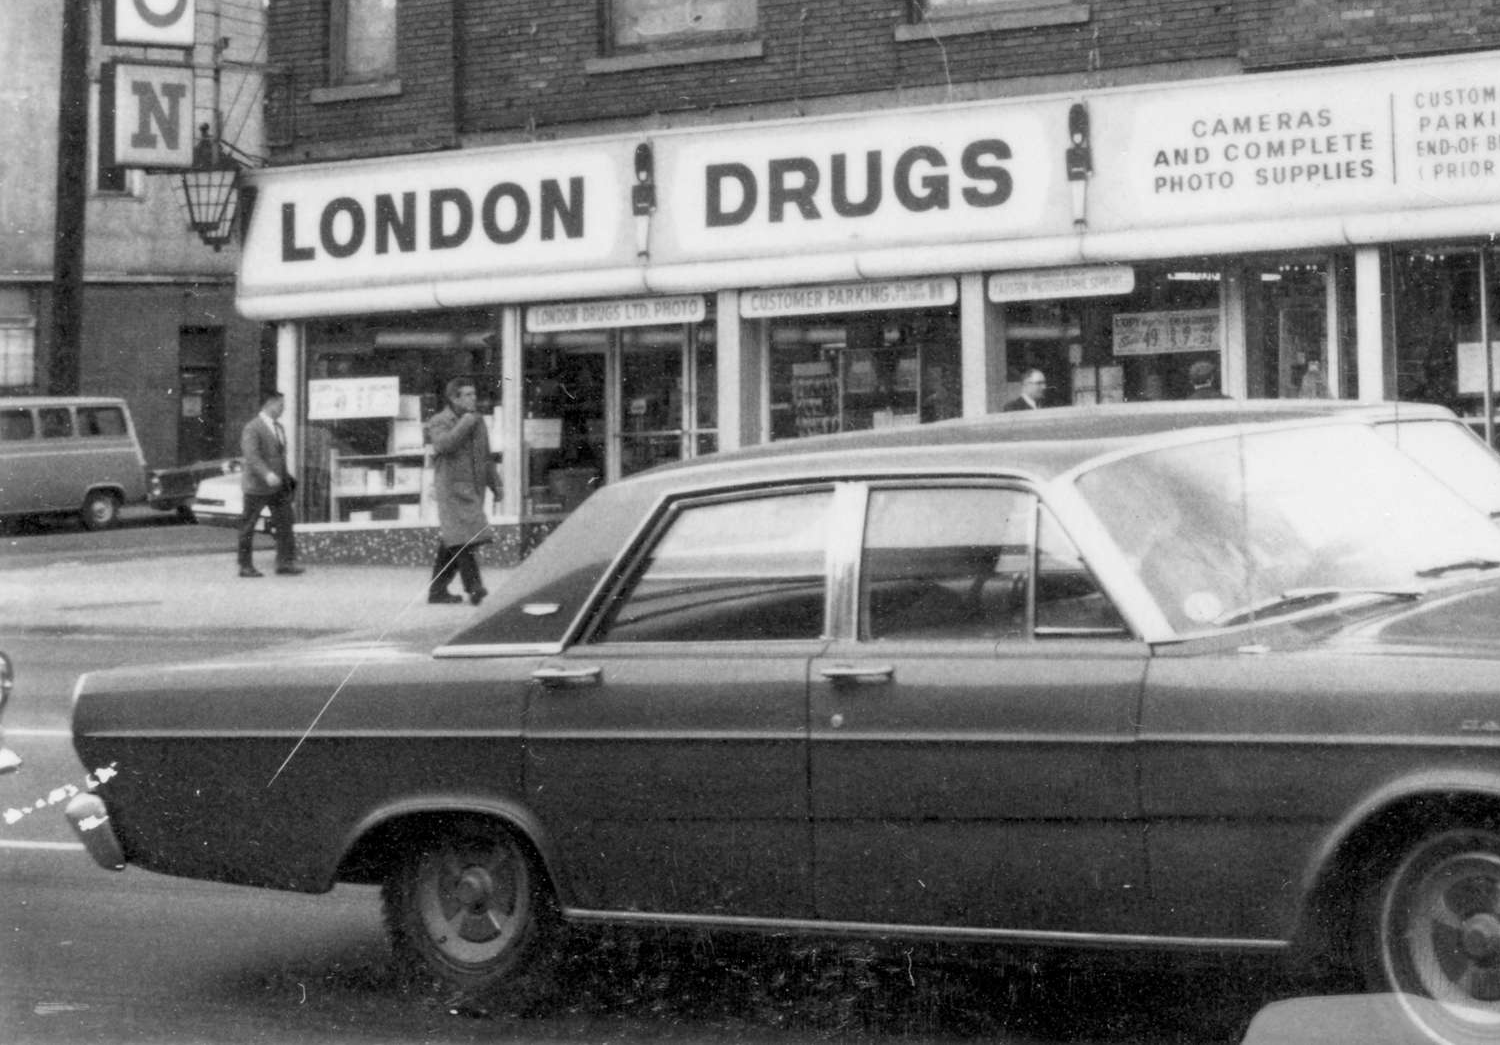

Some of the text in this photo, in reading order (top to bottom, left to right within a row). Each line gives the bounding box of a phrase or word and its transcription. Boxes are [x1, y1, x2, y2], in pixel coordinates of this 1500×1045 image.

[1191, 108, 1333, 139] CAMERAS
[1153, 131, 1375, 168] AND COMPLETE
[1416, 139, 1451, 158] END
[1457, 136, 1480, 155] OF
[1154, 158, 1375, 195] PHOTO SUPPLIES
[281, 138, 1013, 262] LONDON DRUGS
[582, 303, 621, 323] DRUGS
[654, 298, 698, 318] PHOTO
[751, 290, 823, 312] CUSTOMER
[828, 284, 890, 305] PARKING
